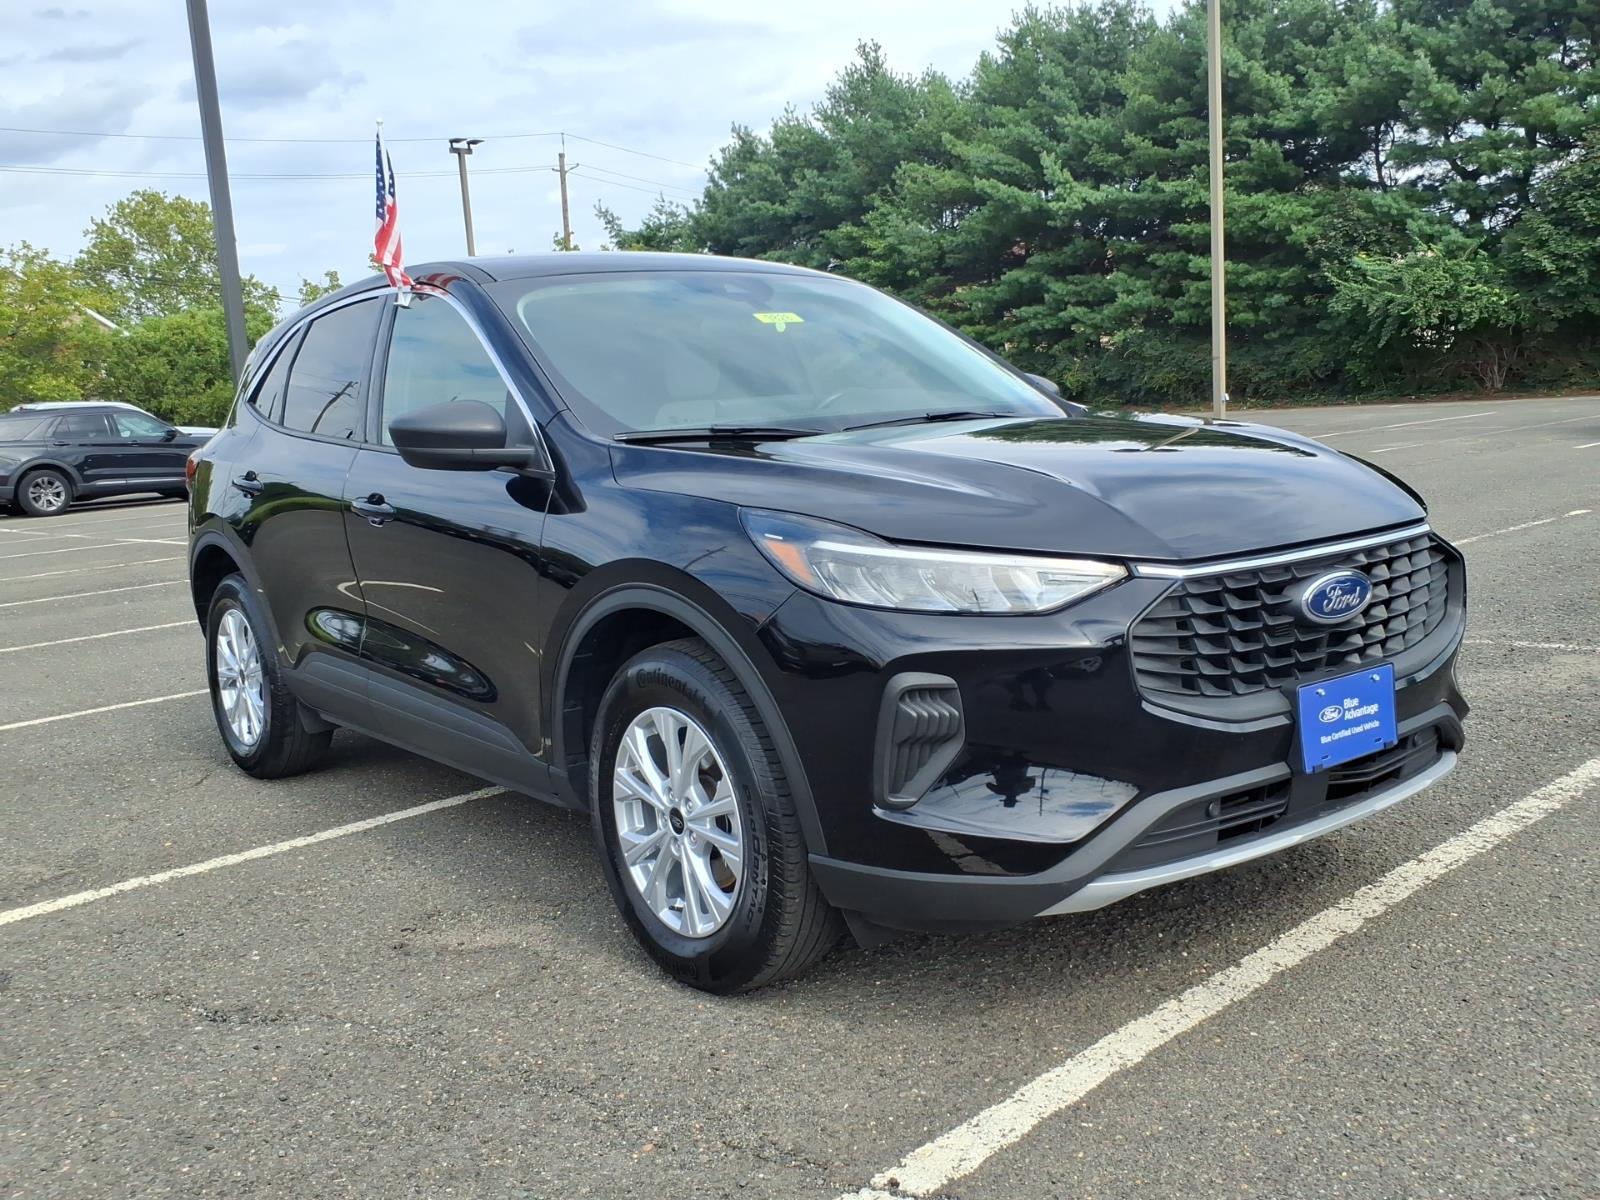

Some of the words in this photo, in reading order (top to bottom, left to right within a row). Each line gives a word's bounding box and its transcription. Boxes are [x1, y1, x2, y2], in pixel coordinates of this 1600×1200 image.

[1322, 582, 1361, 613] Ford
[636, 667, 699, 704] Continental
[1343, 697, 1360, 709] Blue
[1344, 703, 1379, 720] Advantage
[1320, 735, 1332, 744] Blue
[1331, 728, 1351, 740] Certified
[1351, 725, 1364, 734] Used
[1363, 719, 1380, 730] Vehicle
